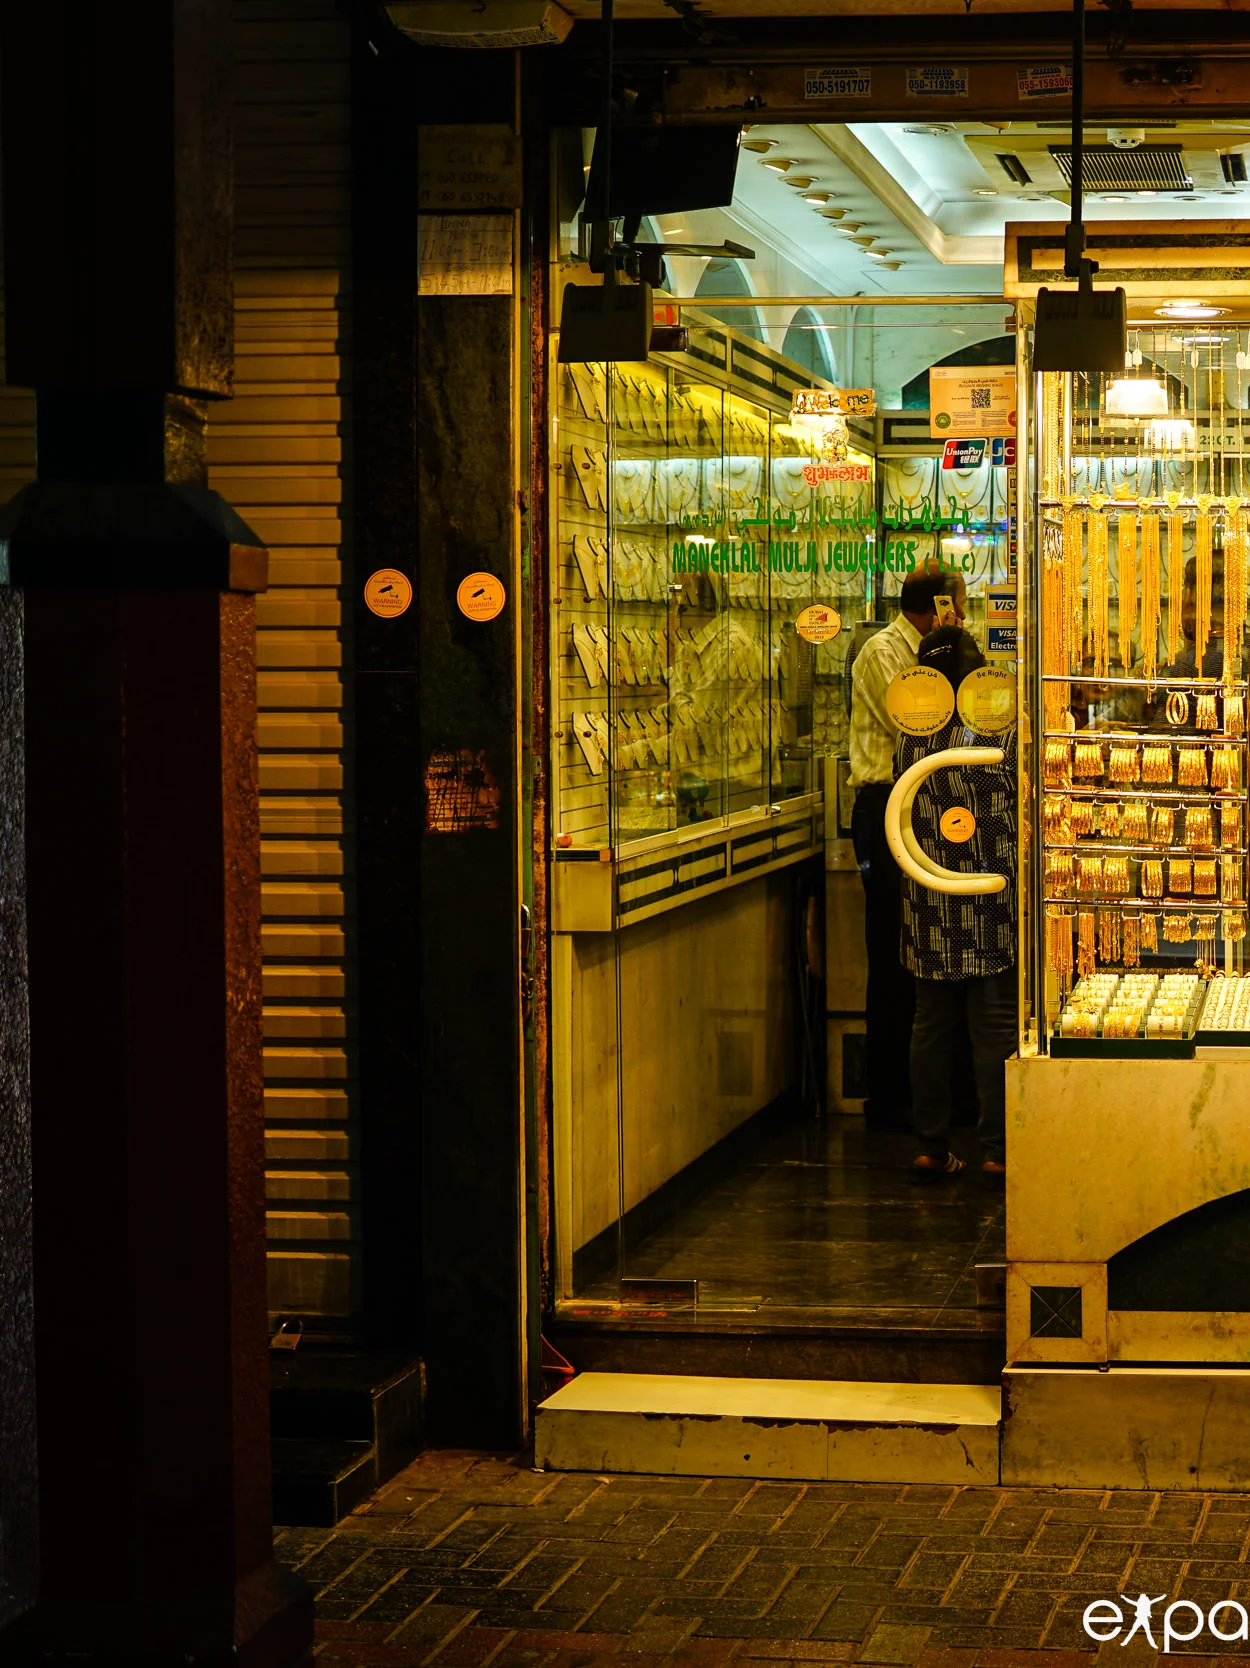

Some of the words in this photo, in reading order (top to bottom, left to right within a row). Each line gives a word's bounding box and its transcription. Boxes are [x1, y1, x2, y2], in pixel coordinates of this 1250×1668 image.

[806, 79, 870, 94] 050-5191707
[909, 79, 966, 89] 050-1193958
[946, 446, 983, 458] UnionPay
[992, 447, 1015, 457] JC
[672, 541, 760, 573] MANEKLAL
[768, 541, 817, 573] MULJI
[824, 541, 916, 573] JEWELLERS
[467, 601, 497, 609] WARNING
[976, 671, 986, 679] Be
[987, 669, 1007, 679] Right
